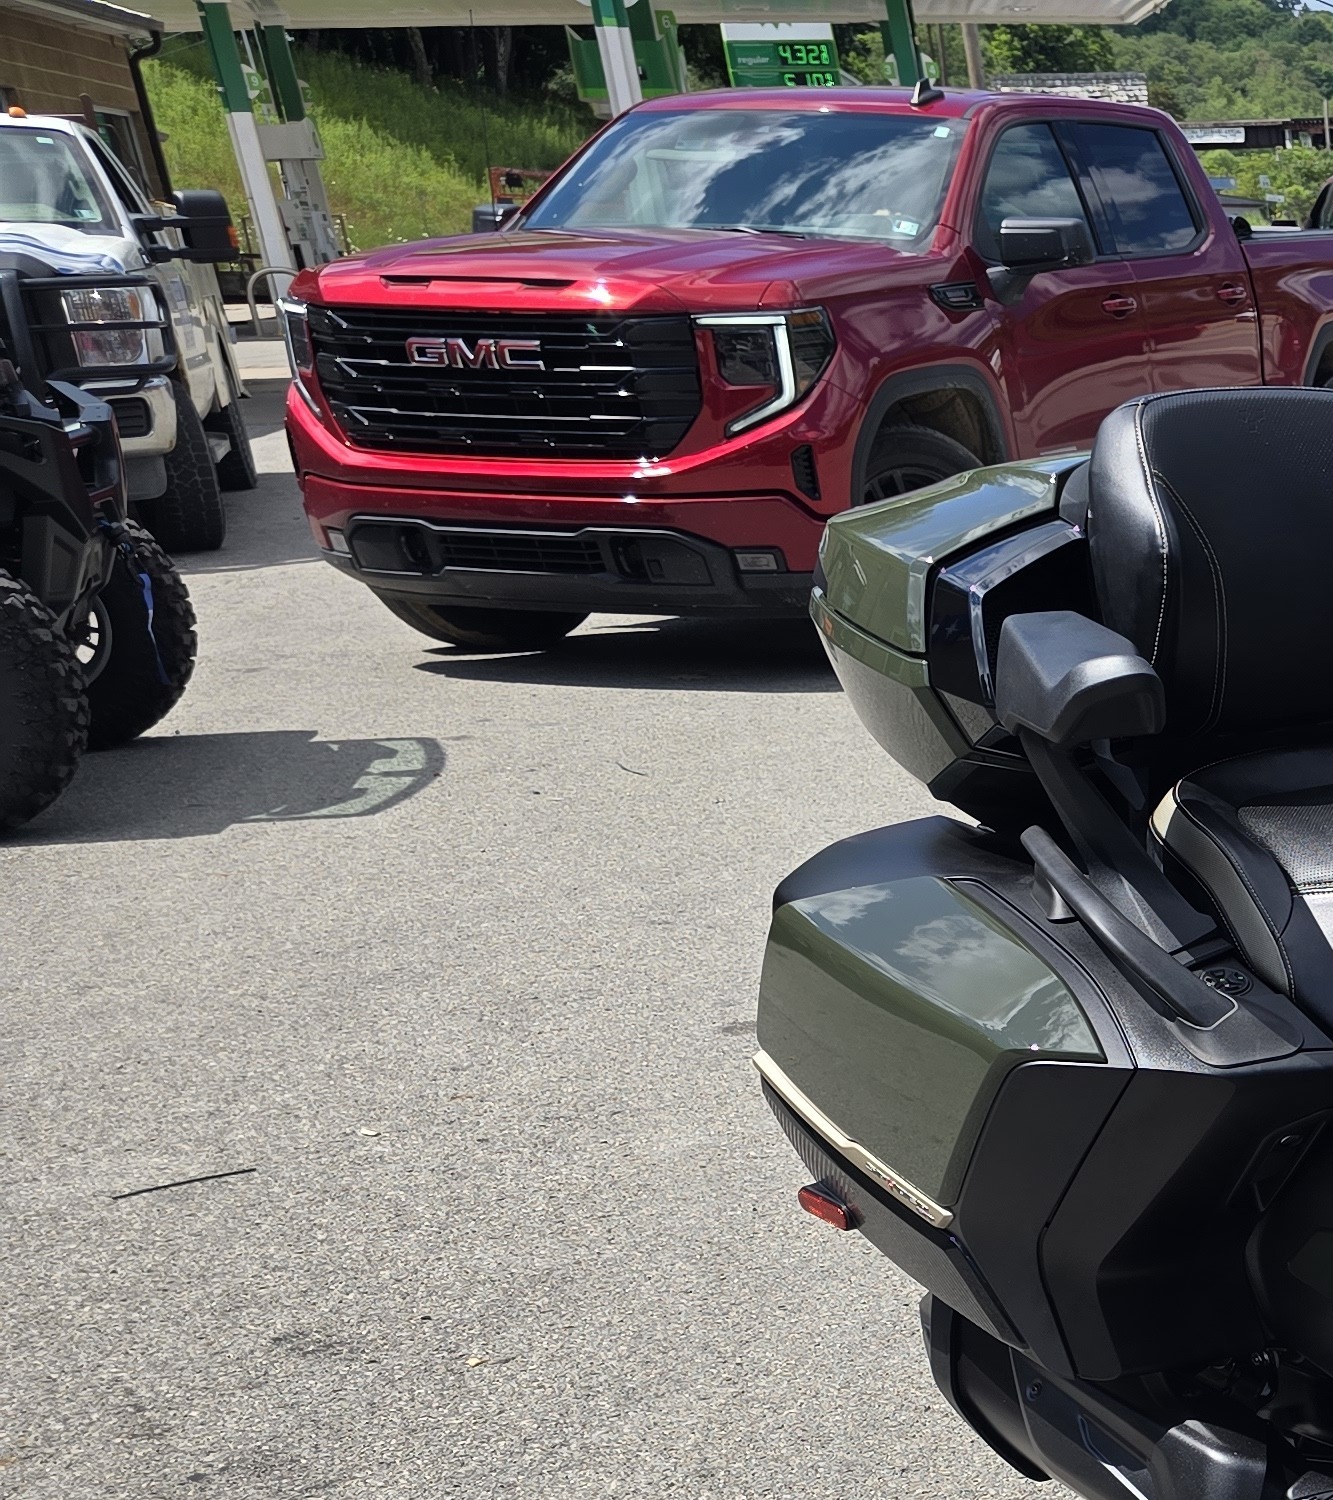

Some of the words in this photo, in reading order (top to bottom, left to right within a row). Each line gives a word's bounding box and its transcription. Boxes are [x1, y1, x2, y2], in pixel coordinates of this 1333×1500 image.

[661, 15, 671, 28] 6
[884, 65, 893, 75] 3
[928, 65, 937, 75] 4
[405, 337, 546, 371] GMC
